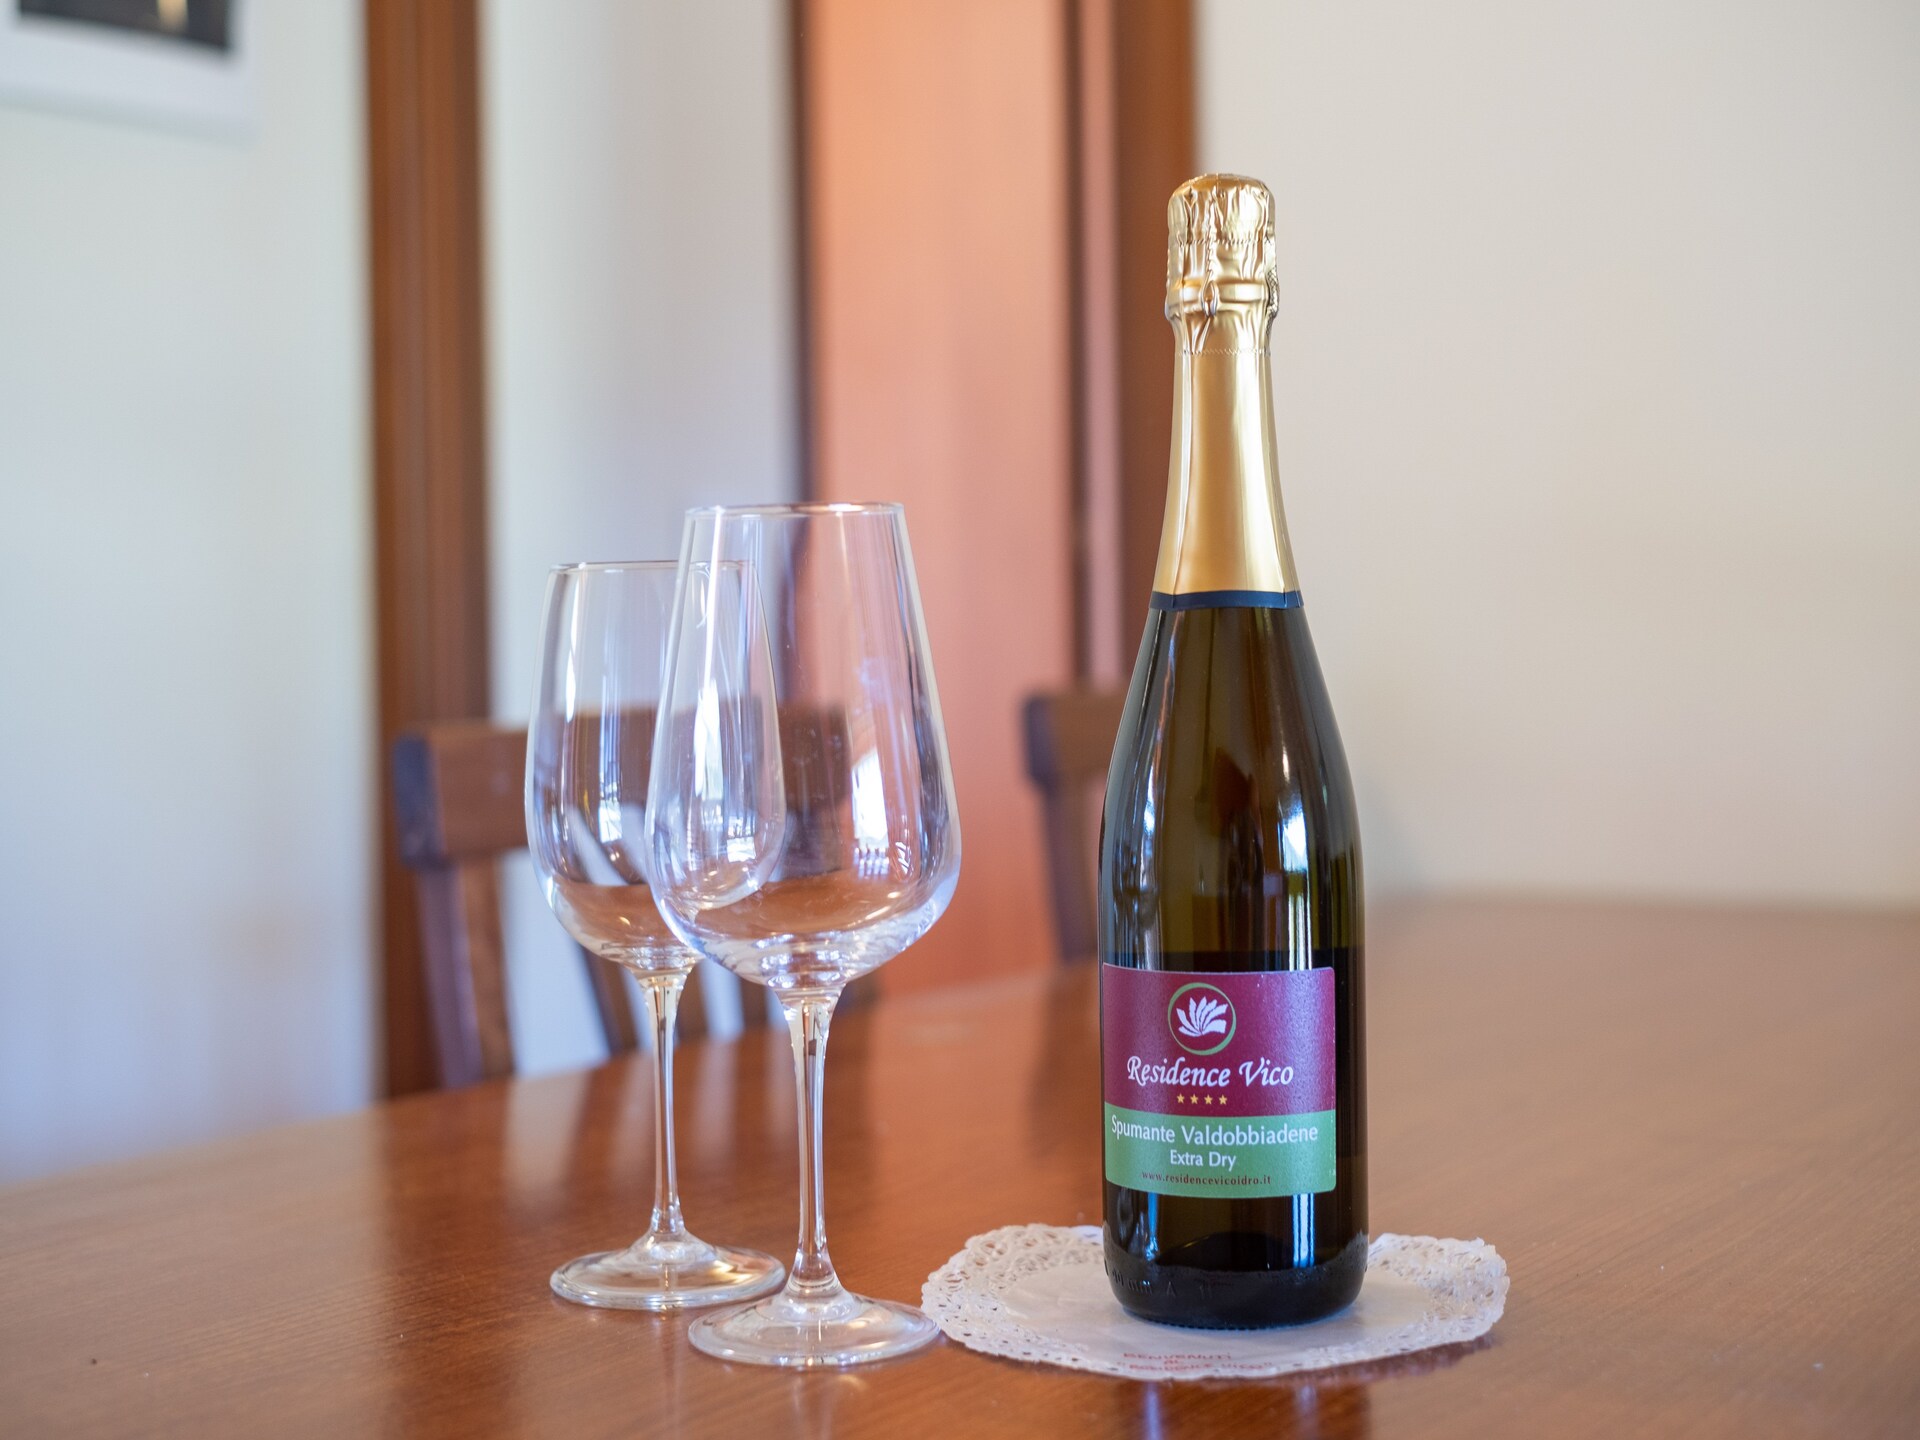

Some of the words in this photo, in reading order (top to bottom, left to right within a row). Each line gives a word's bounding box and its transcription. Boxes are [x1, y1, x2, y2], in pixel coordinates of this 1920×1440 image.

[1127, 1055, 1231, 1087] Residence
[1238, 1057, 1294, 1087] Vico
[1111, 1114, 1176, 1143] Spumante
[1181, 1124, 1319, 1146] Valdobbiadene
[1170, 1149, 1203, 1166] Extra
[1208, 1151, 1237, 1171] Dry
[1141, 1171, 1272, 1186] www.residencevicoidro.it
